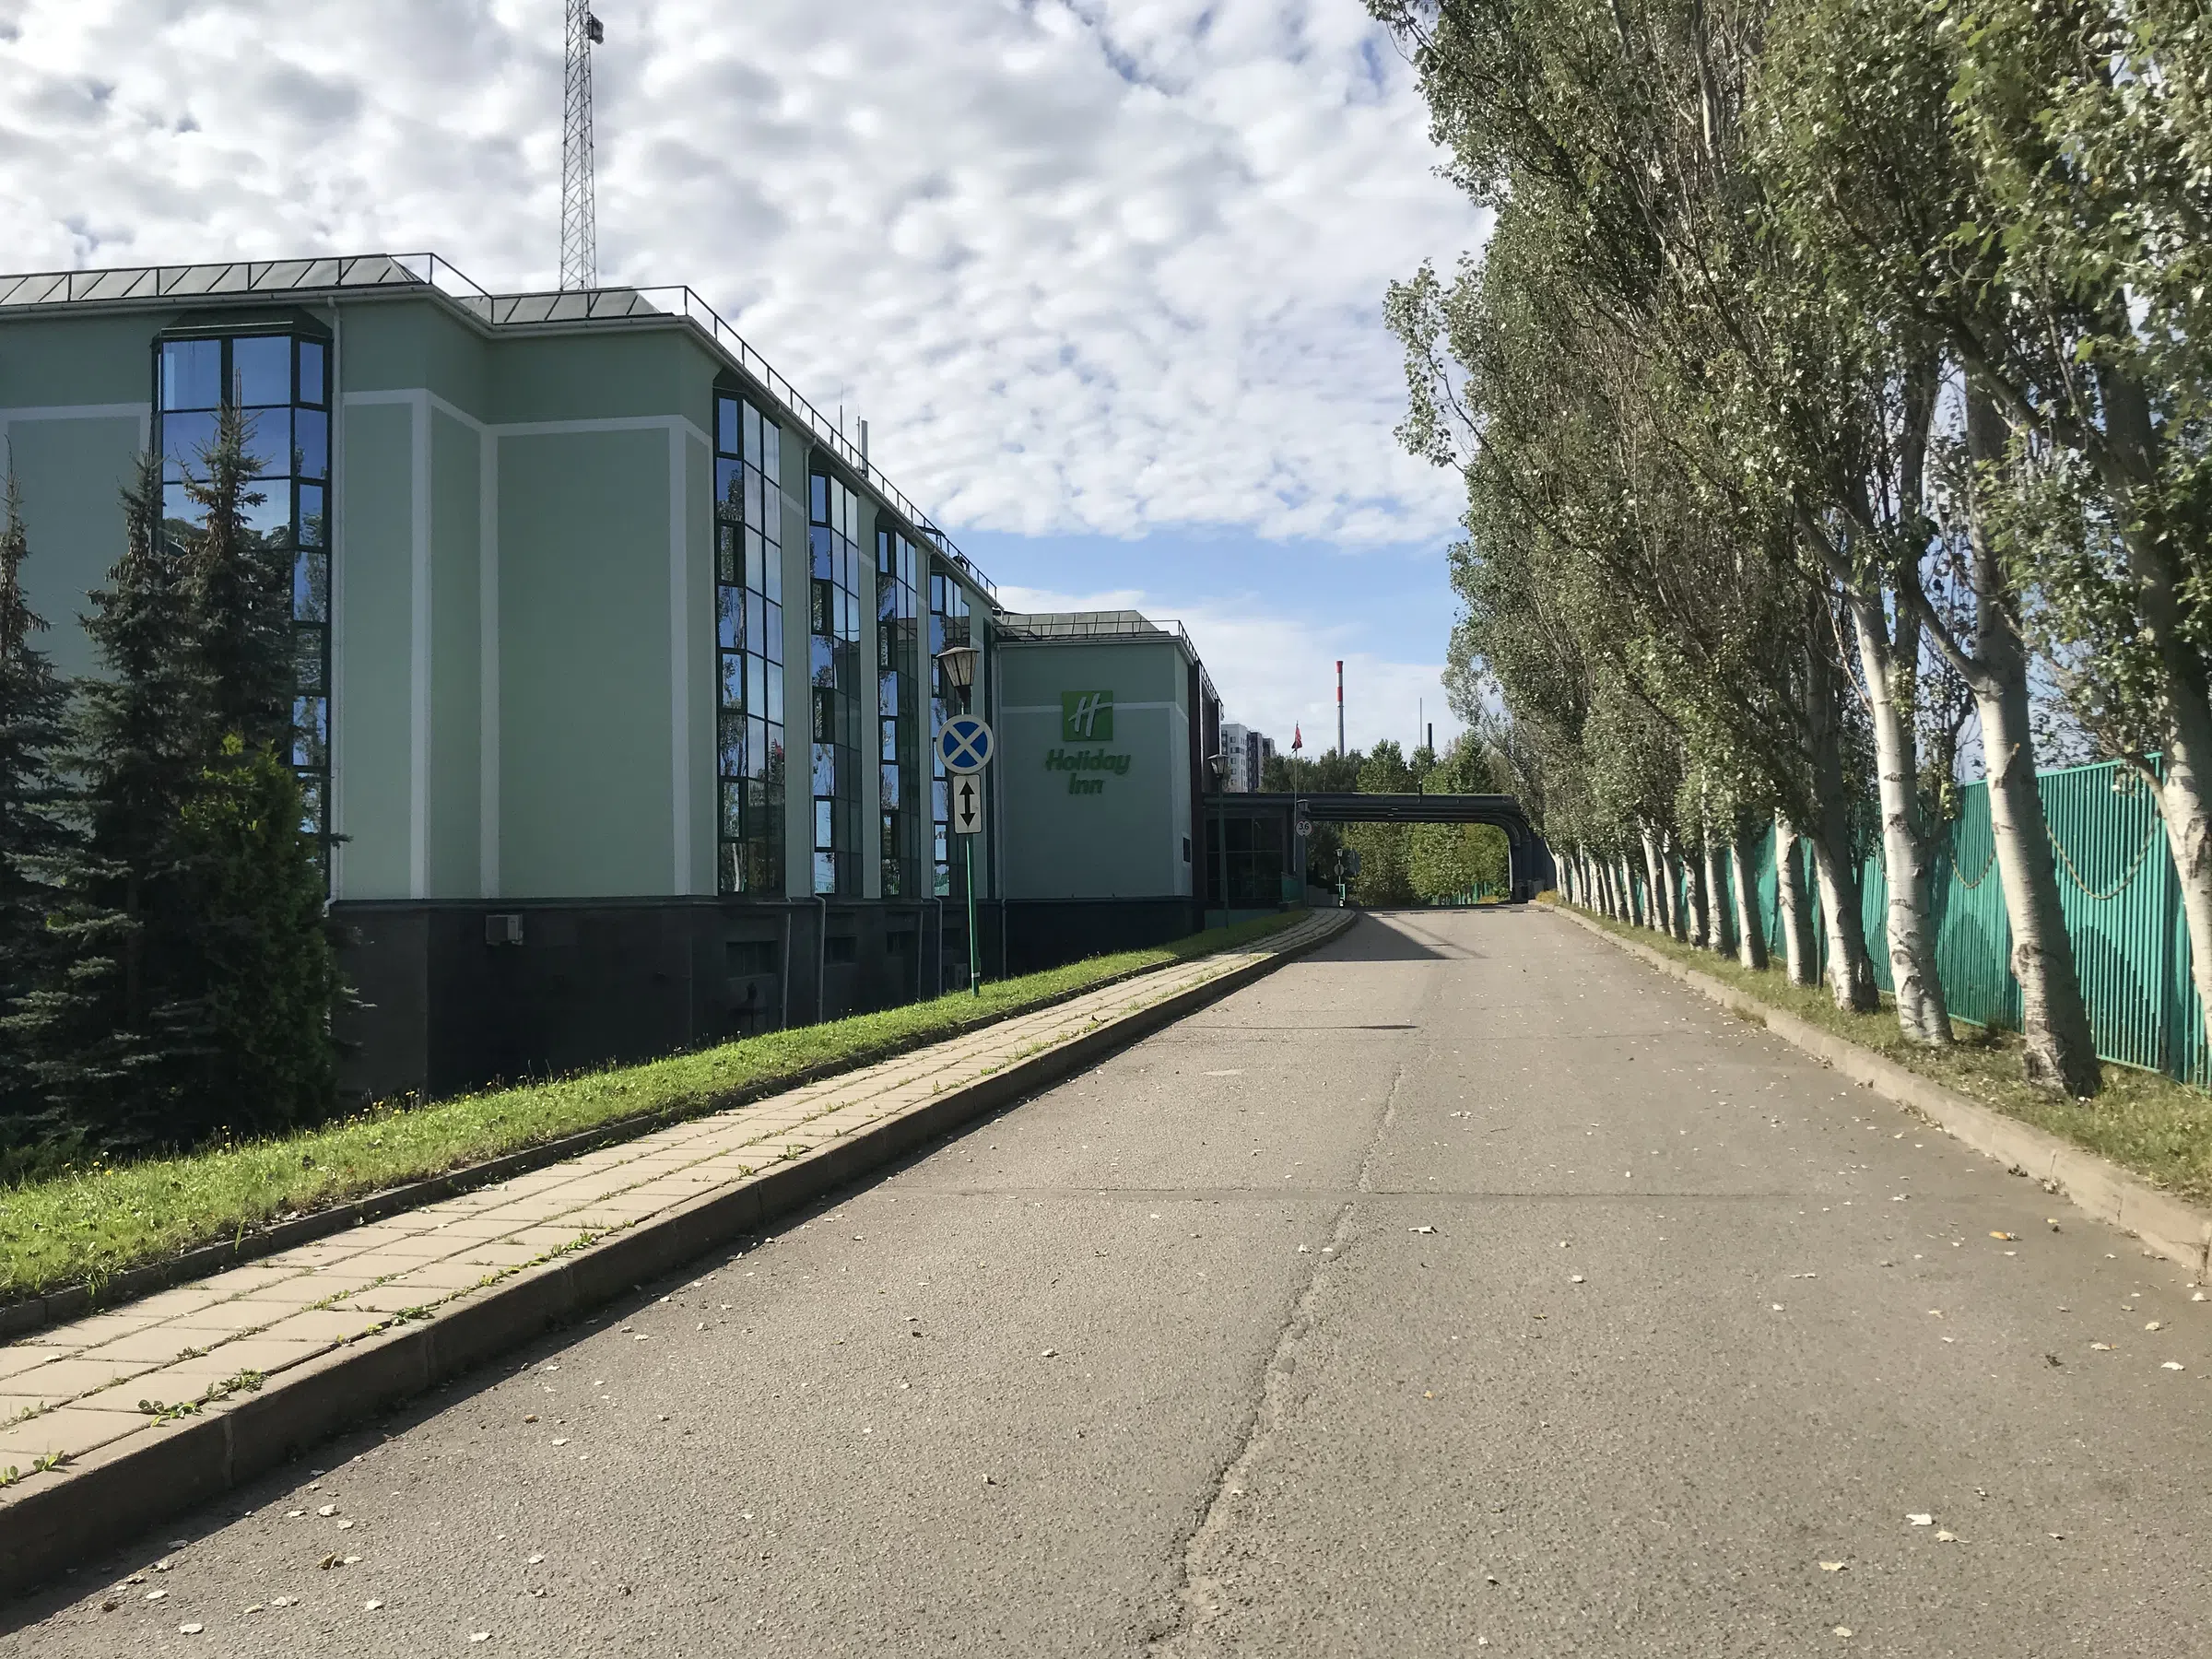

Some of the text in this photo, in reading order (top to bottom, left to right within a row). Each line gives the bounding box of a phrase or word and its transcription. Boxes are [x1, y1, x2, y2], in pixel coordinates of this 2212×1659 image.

[1068, 693, 1112, 737] H
[1045, 748, 1131, 775] Holiday
[1069, 773, 1104, 794] Inn
